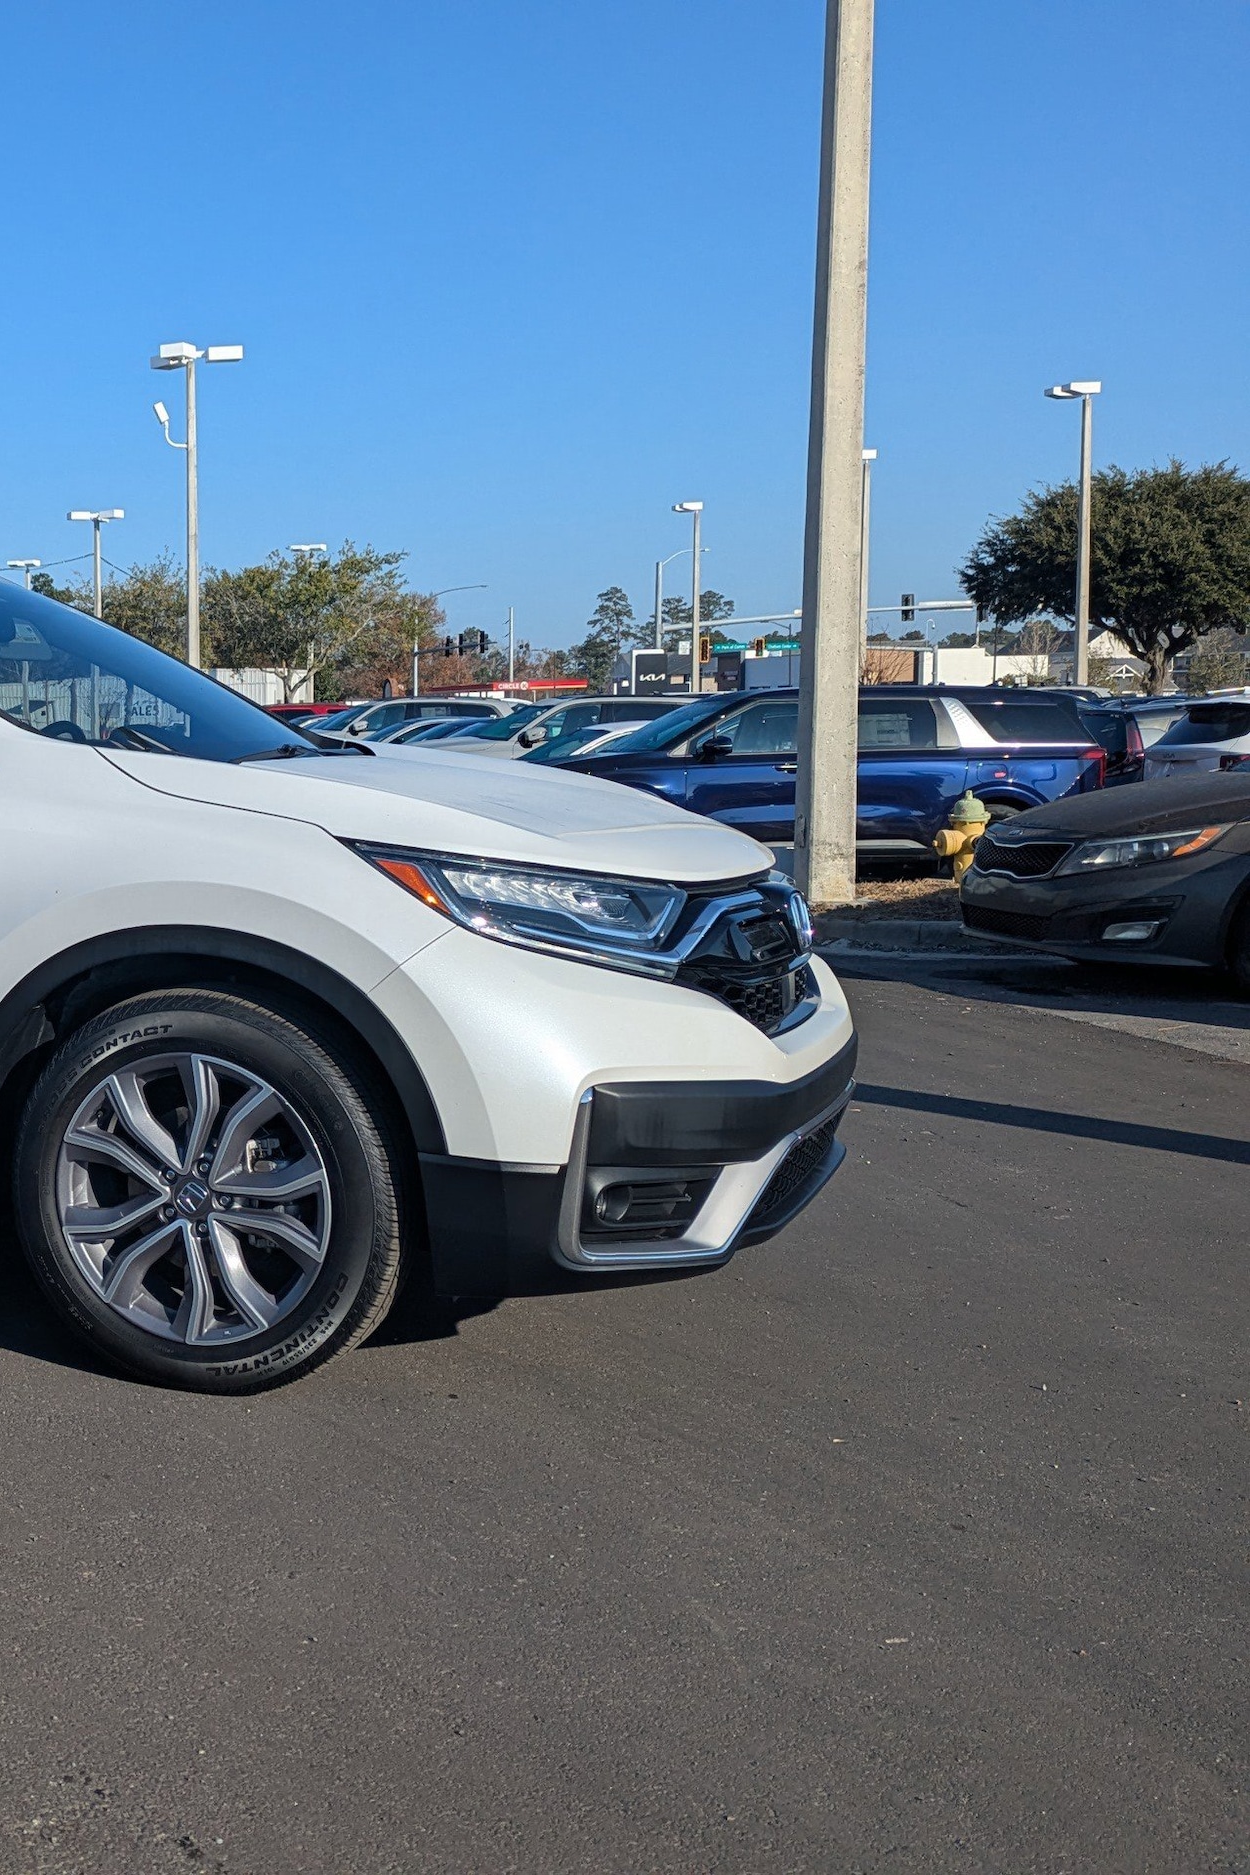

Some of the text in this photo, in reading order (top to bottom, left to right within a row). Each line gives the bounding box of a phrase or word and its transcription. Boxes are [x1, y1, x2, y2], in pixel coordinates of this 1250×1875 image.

[640, 673, 666, 681] KIA
[80, 1025, 173, 1069] CONTACT
[205, 1272, 349, 1377] CONTINENTAL
